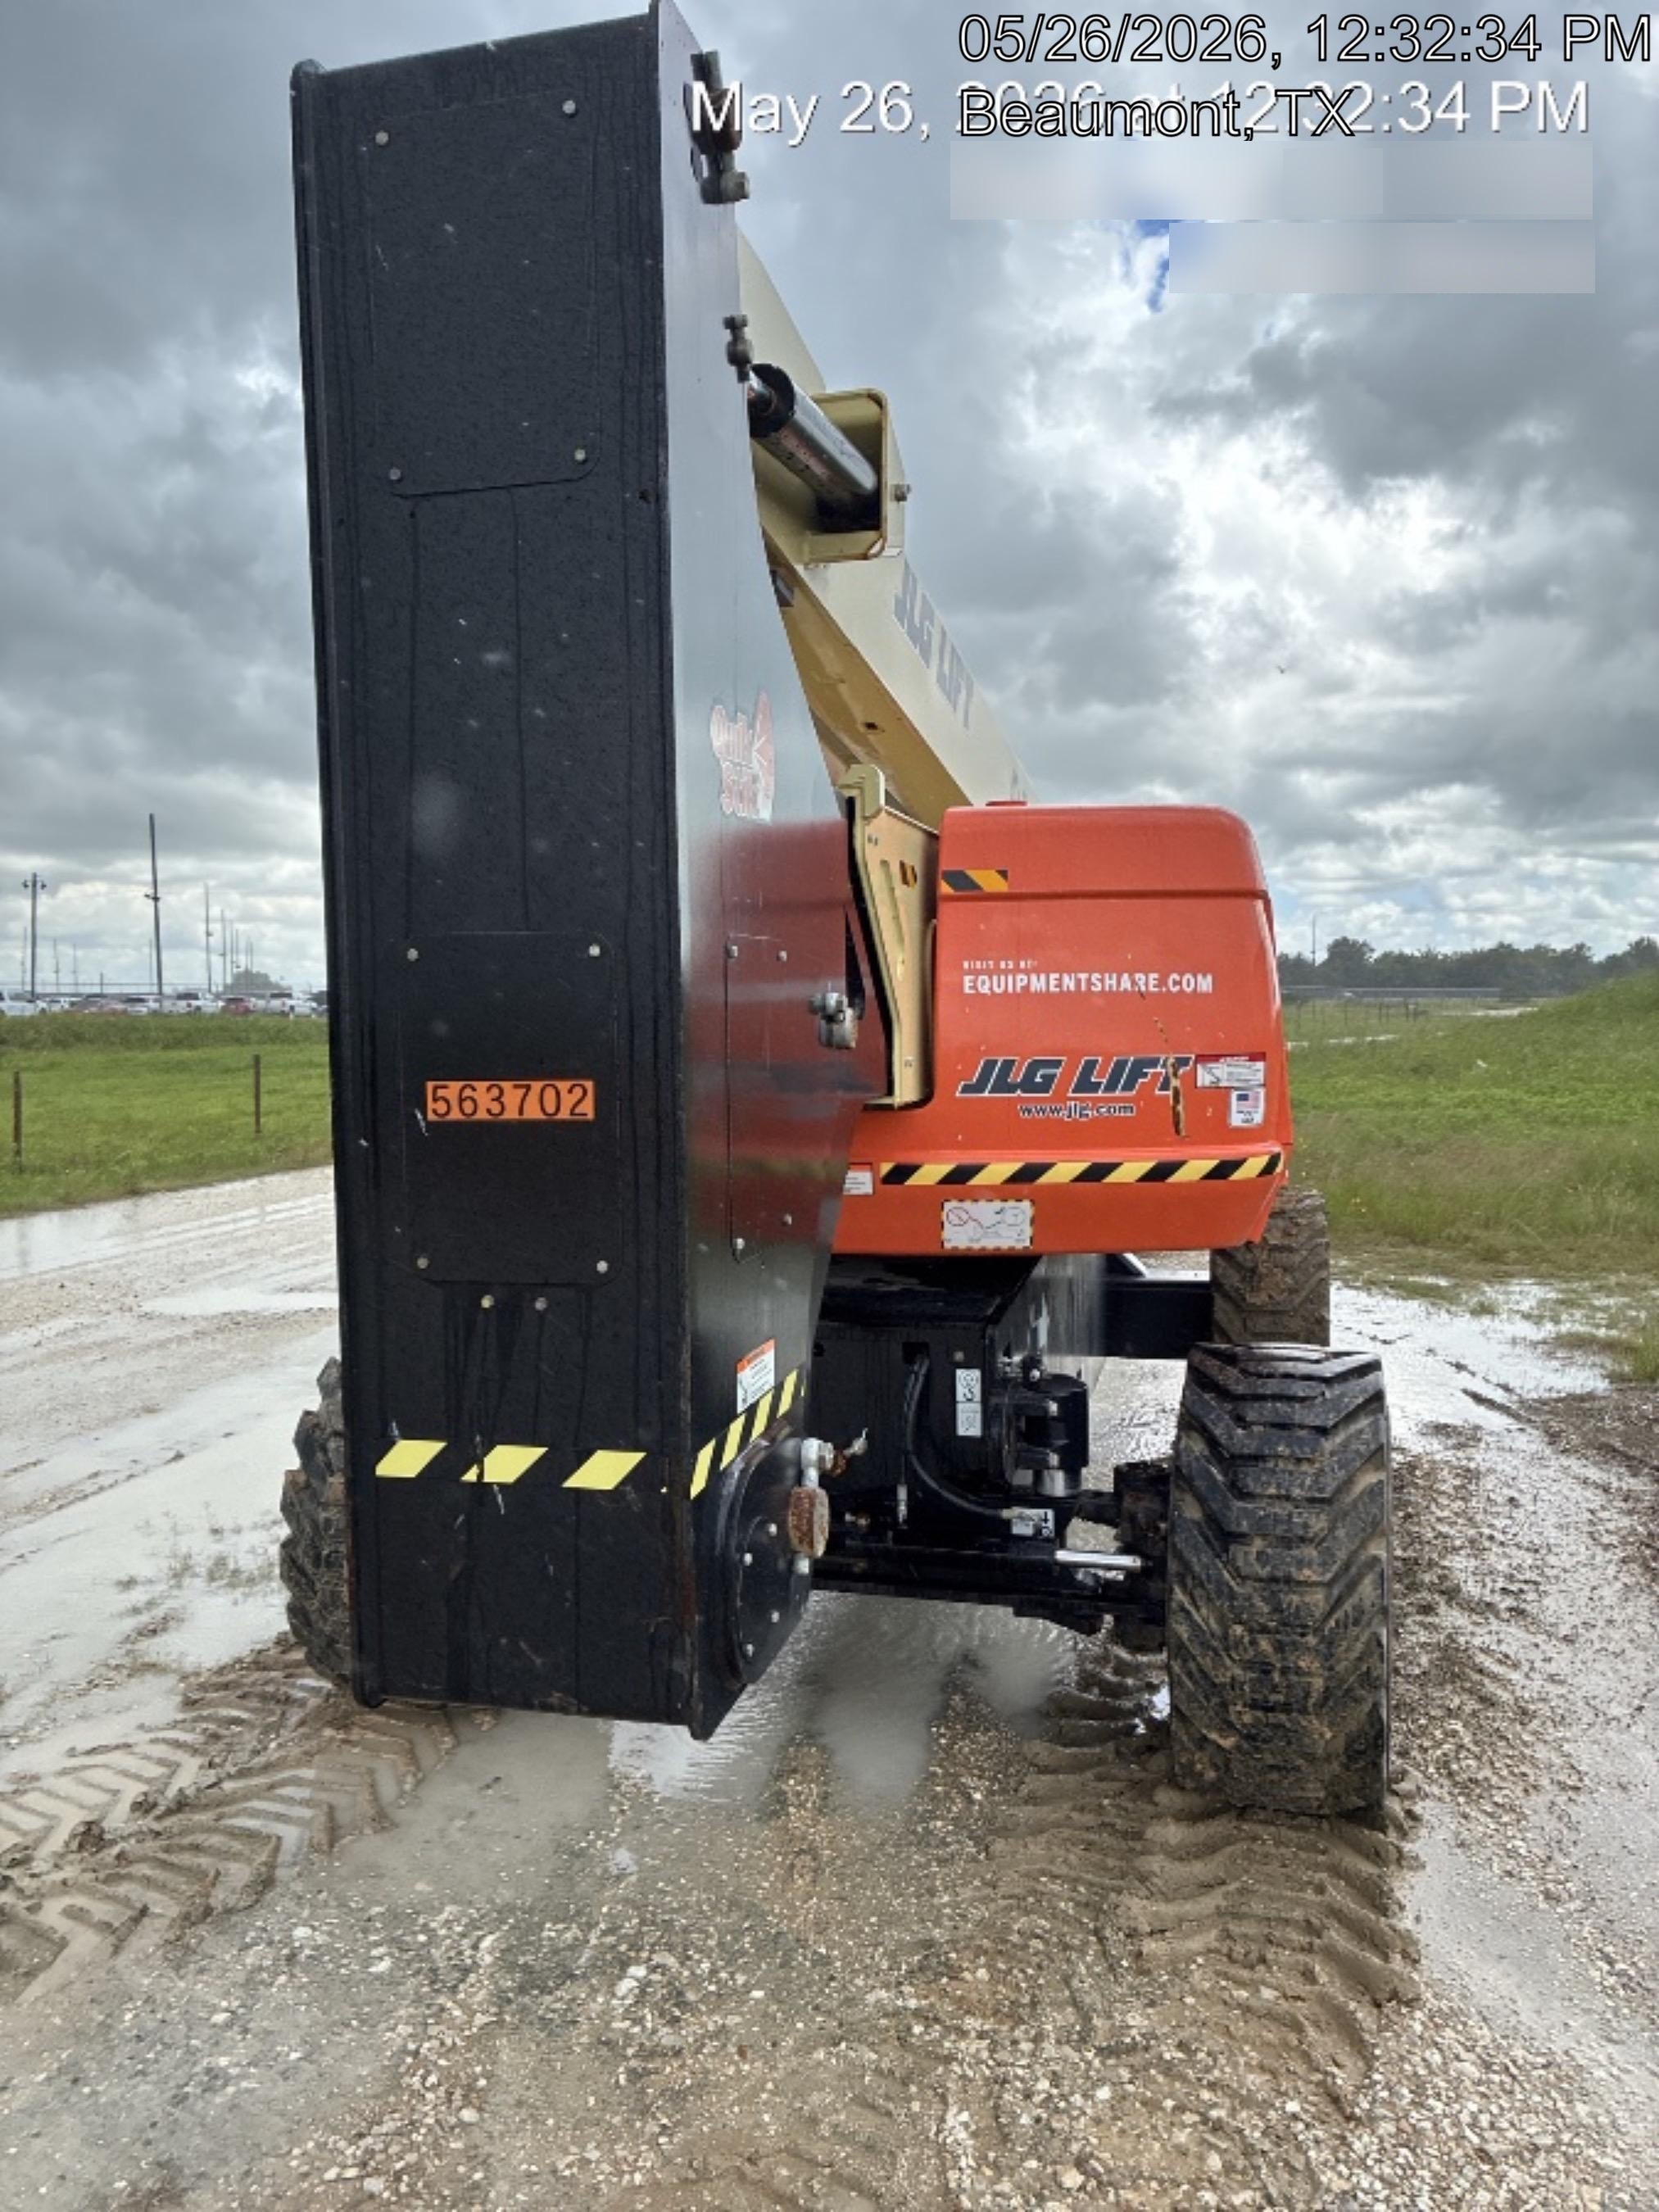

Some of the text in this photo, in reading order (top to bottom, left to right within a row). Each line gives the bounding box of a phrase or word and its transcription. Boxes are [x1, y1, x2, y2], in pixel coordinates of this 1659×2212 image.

[894, 557, 974, 732] JLG LIFT
[963, 972, 1213, 995] EQUIPMENTSHARE.COM
[956, 1057, 1066, 1096] JLG
[1067, 1054, 1194, 1096] LIFT
[431, 1083, 588, 1117] 563702
[1018, 1100, 1135, 1121] www.jlg.com
